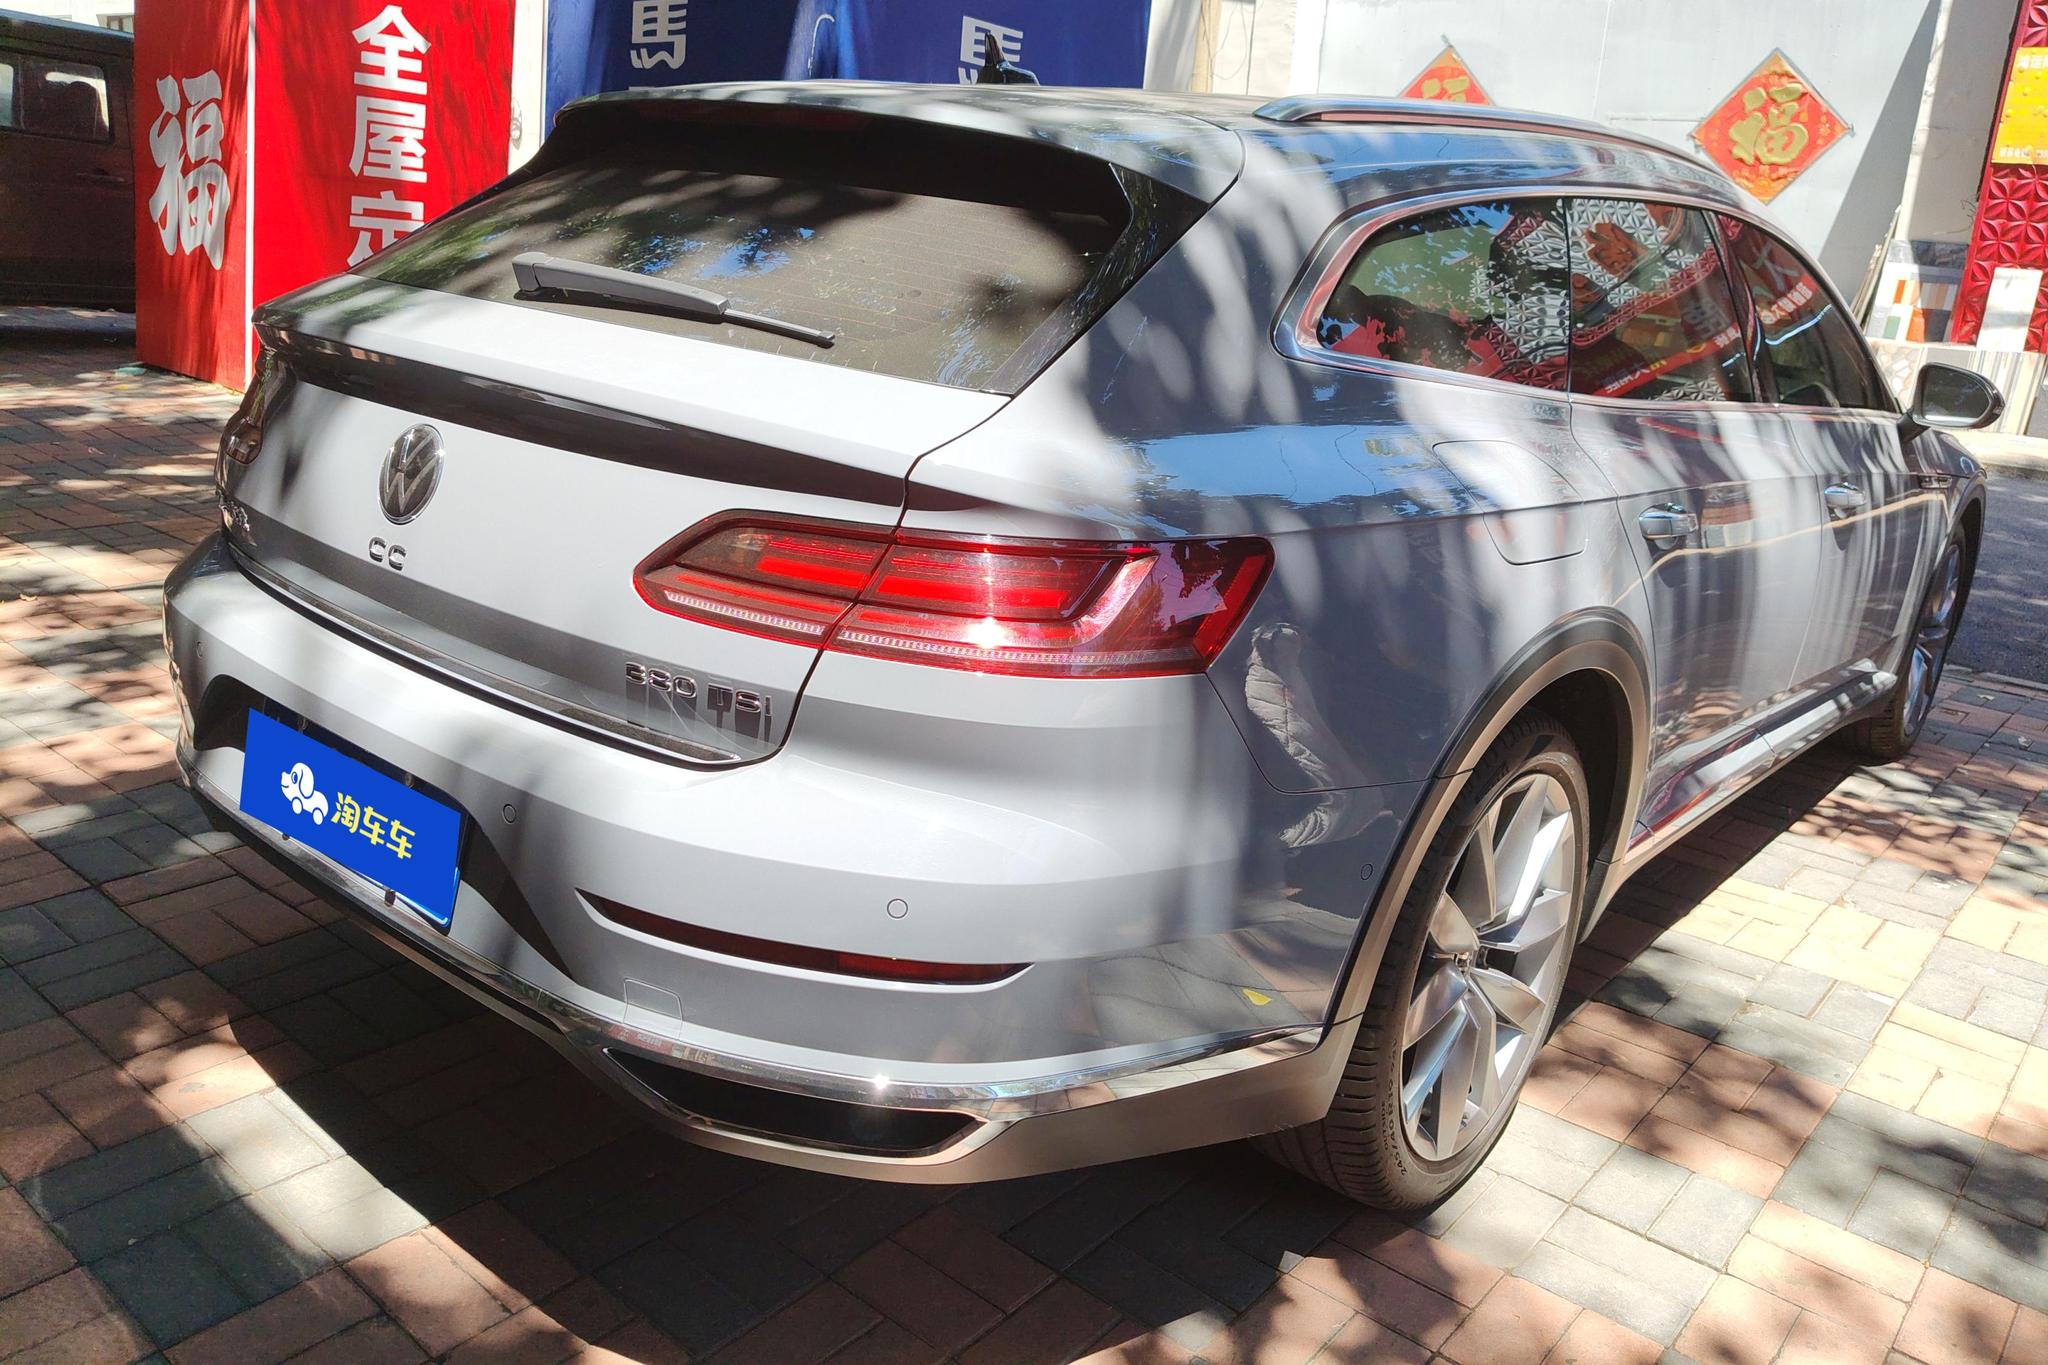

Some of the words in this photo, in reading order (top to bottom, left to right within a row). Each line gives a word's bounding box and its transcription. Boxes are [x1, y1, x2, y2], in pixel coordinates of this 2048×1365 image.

[1728, 83, 1809, 165] 福
[149, 69, 231, 270] 福
[368, 536, 407, 571] CC
[707, 683, 773, 717] TSI
